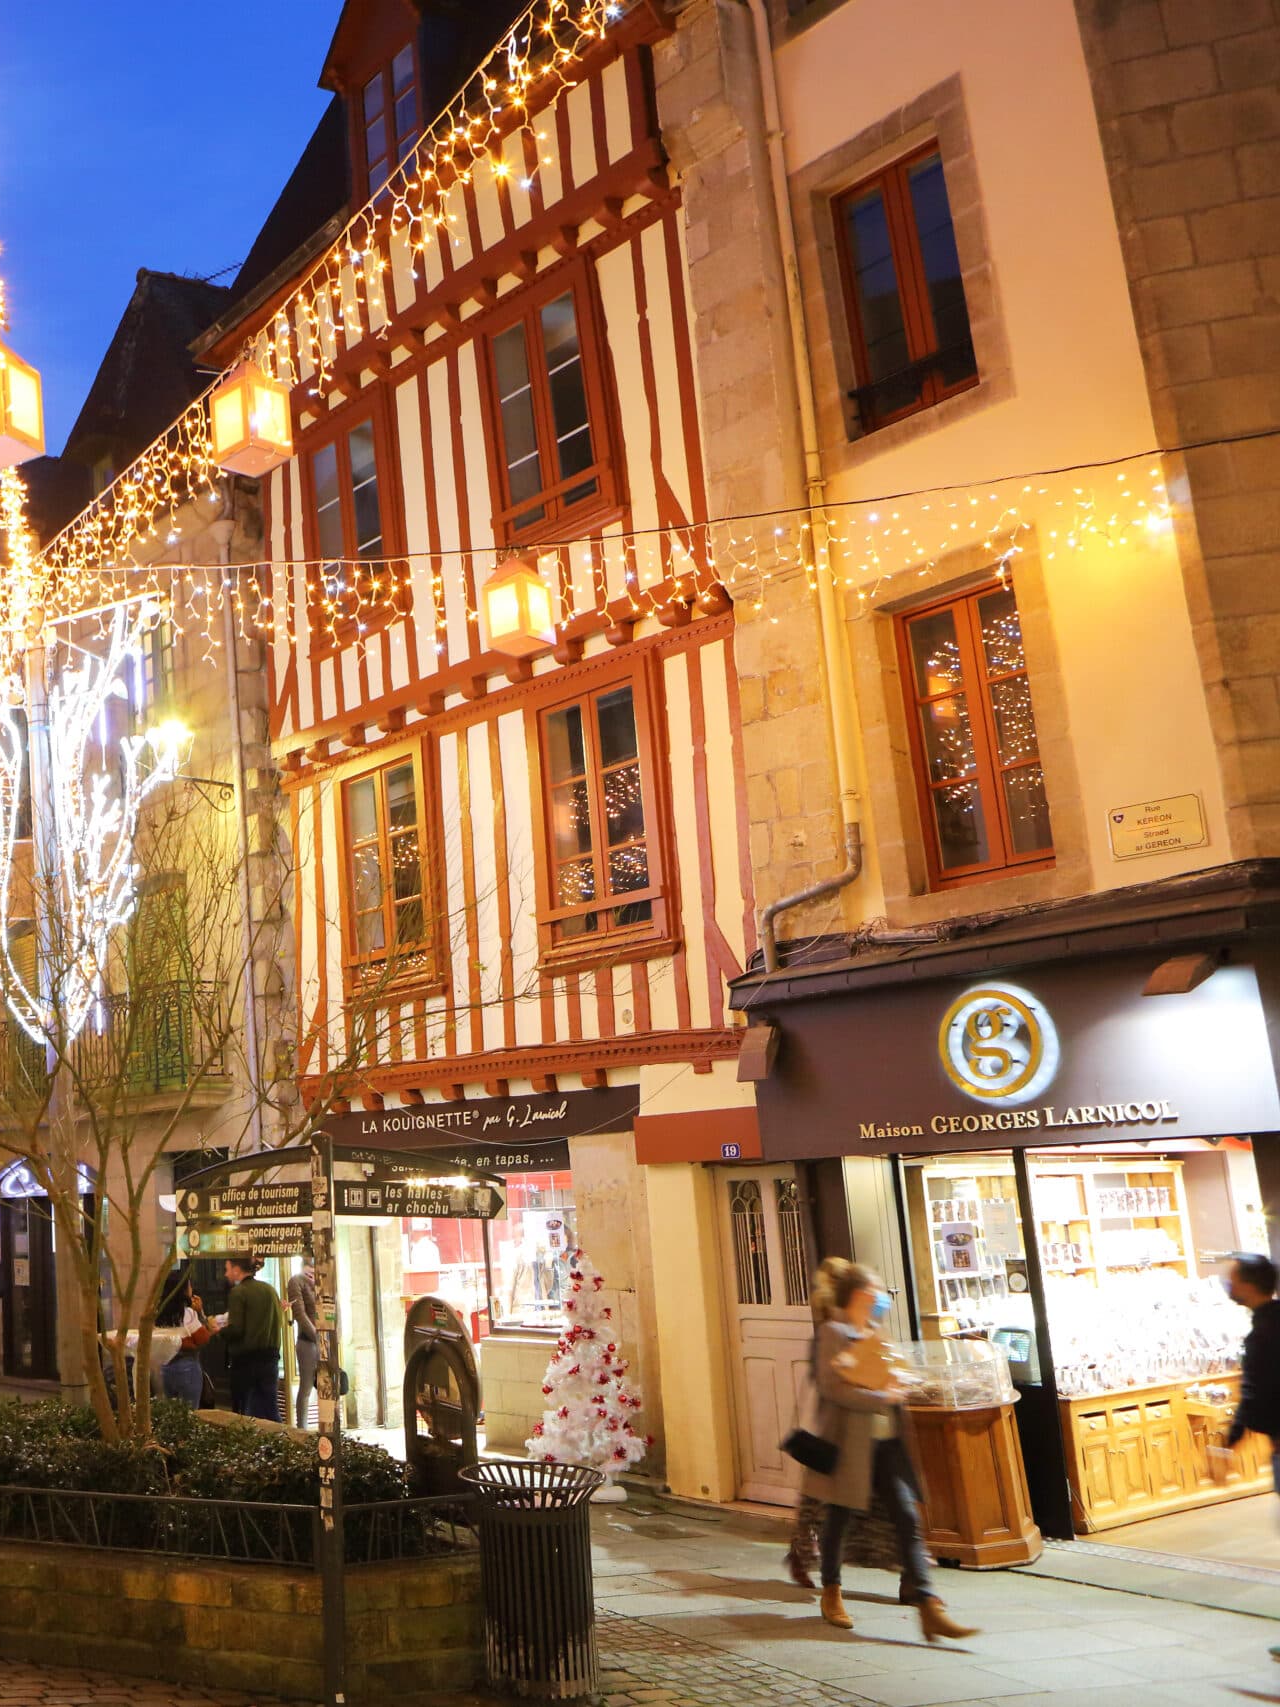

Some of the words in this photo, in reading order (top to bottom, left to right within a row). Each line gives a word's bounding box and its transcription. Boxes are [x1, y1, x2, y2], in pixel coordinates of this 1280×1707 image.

[1144, 805, 1161, 813] Rue
[1143, 829, 1170, 839] Straed
[859, 1122, 924, 1140] Maison
[930, 1109, 1041, 1135] GEORGES
[1044, 1099, 1180, 1130] LARNICOL
[361, 1120, 378, 1134] LA
[724, 1146, 737, 1157] 19
[476, 1156, 490, 1167] en
[222, 1188, 246, 1202] office
[248, 1187, 259, 1200] de
[261, 1184, 300, 1200] tourisme
[385, 1184, 403, 1199] les
[407, 1184, 443, 1200] halles
[244, 1206, 254, 1217] an
[256, 1200, 298, 1216] douristed
[386, 1202, 399, 1213] ar
[248, 1223, 302, 1240] conciergerie
